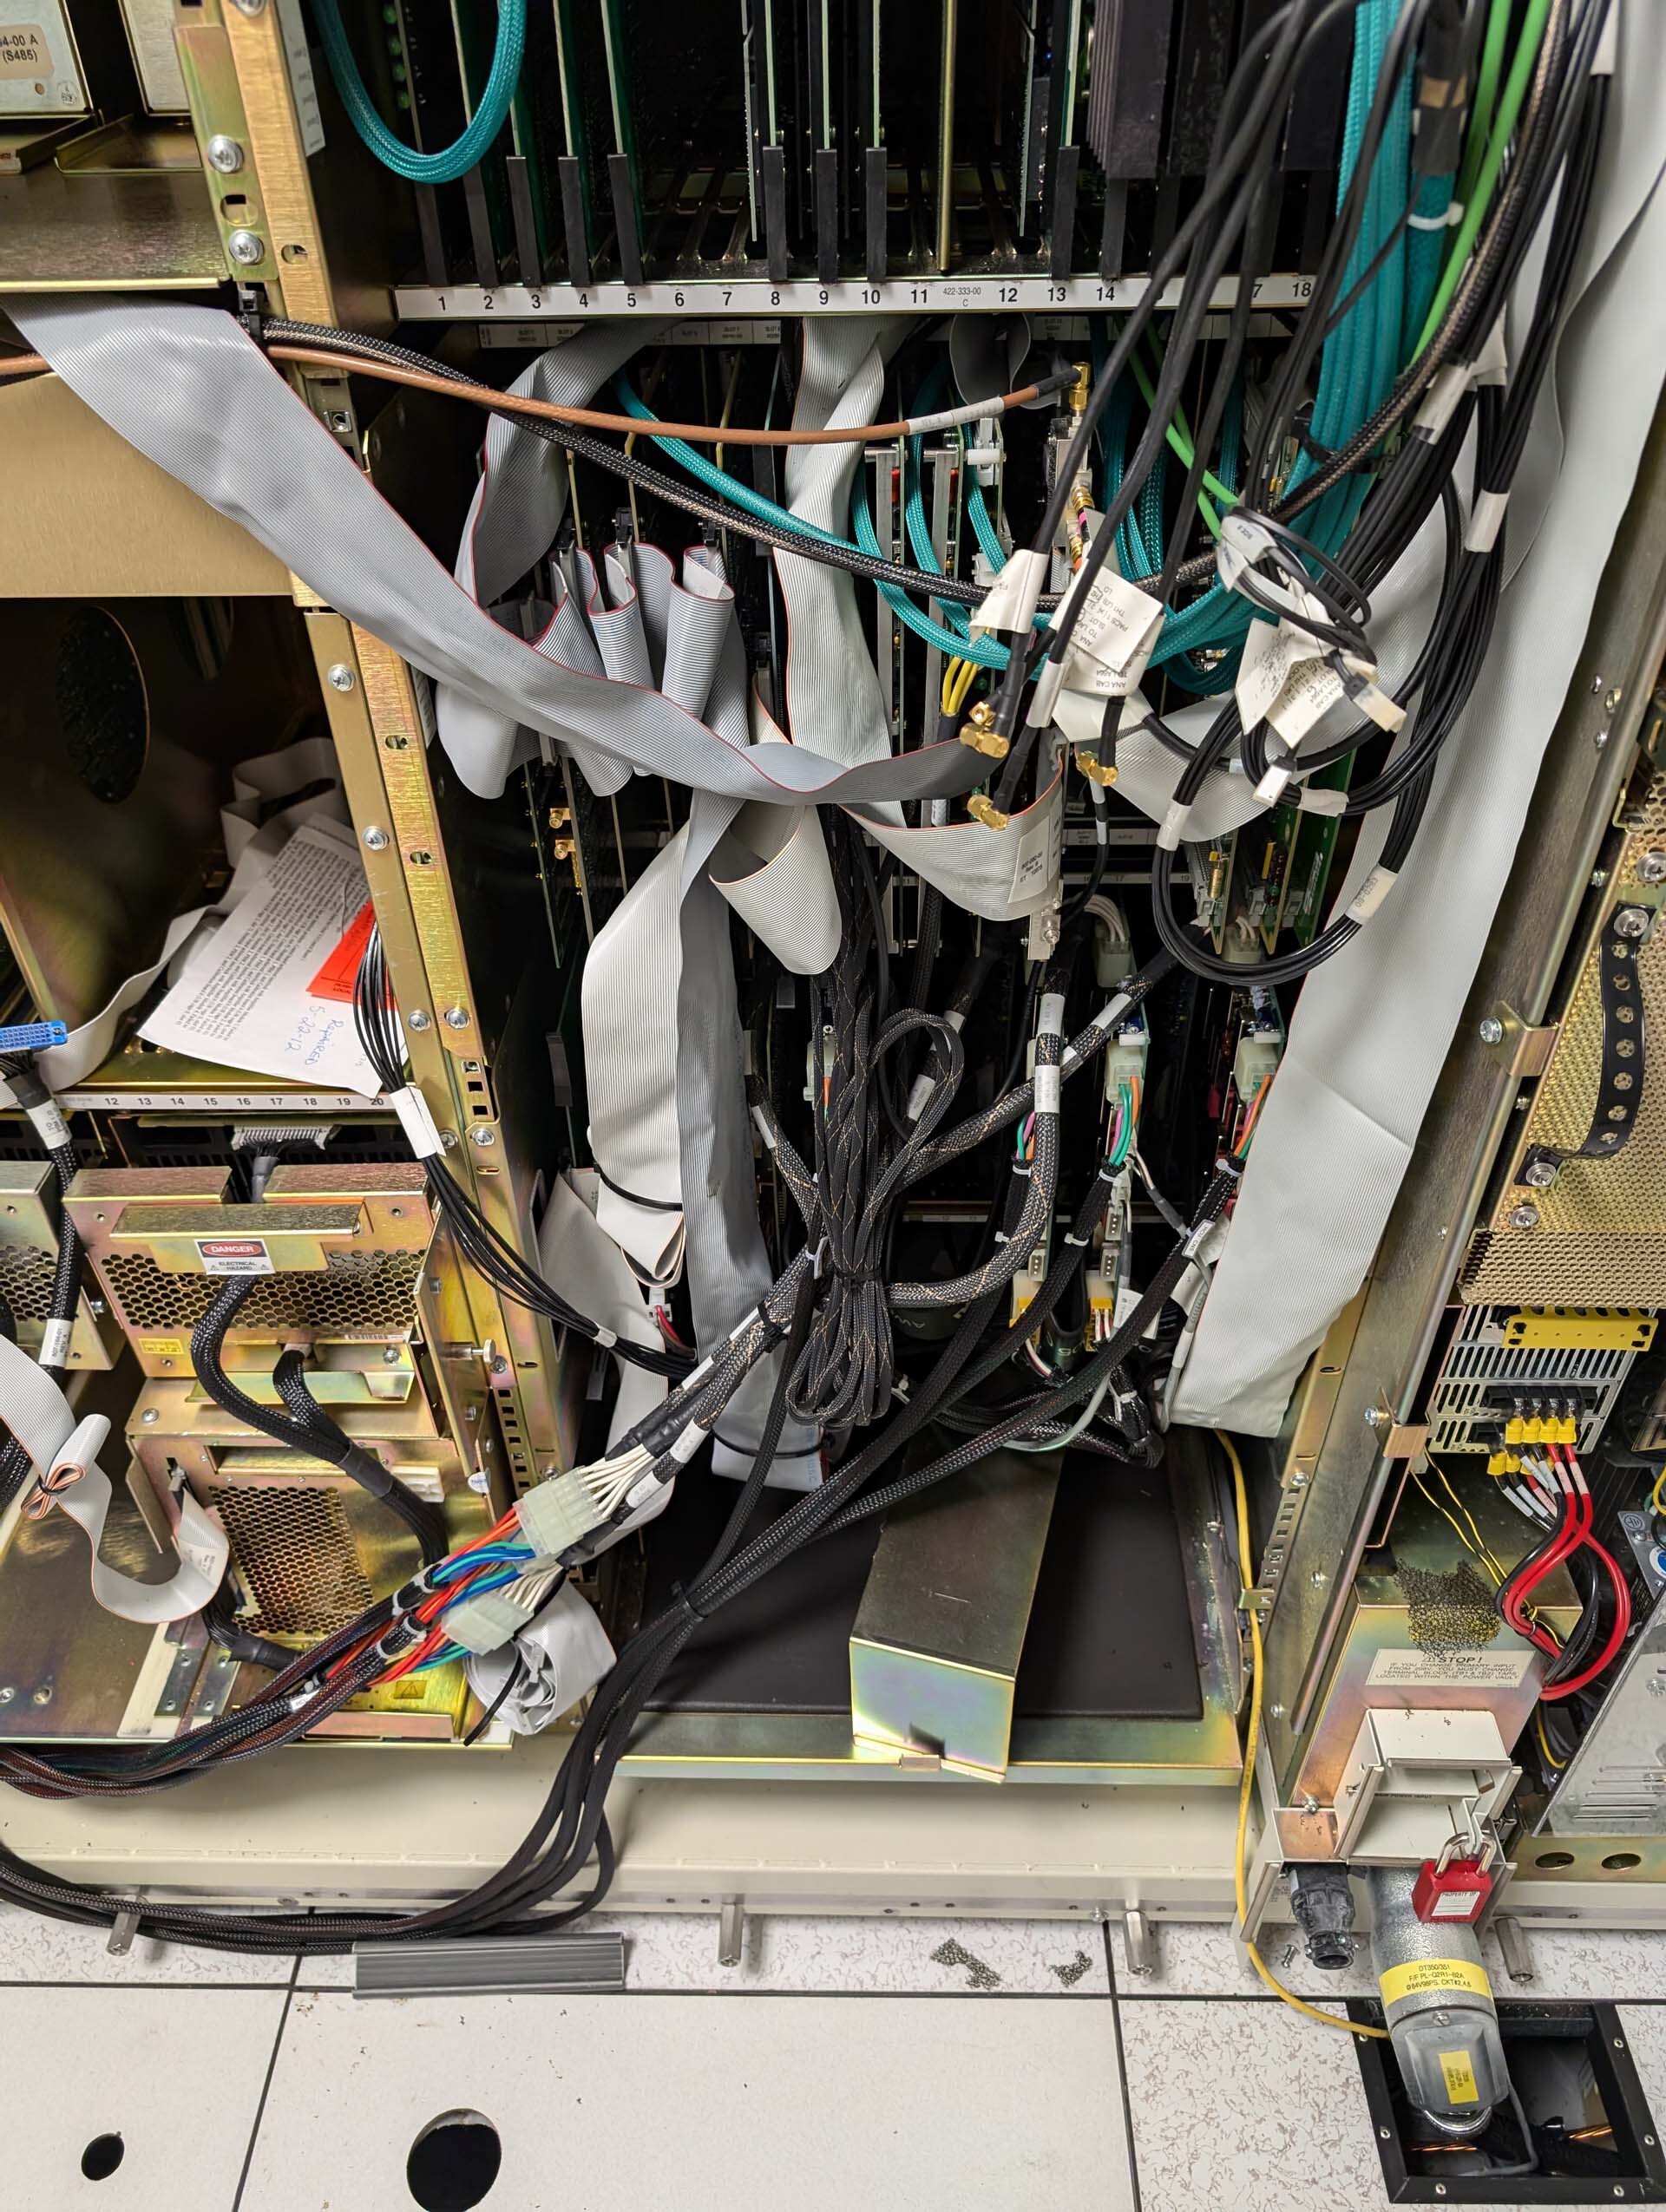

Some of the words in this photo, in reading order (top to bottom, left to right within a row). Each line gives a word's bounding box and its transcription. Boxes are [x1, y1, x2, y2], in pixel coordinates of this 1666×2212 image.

[30, 34, 38, 45] A
[3, 49, 38, 63] (S485)
[438, 296, 447, 311] 1
[483, 296, 494, 310] 2
[530, 294, 541, 309] 3
[579, 293, 589, 308] 4
[626, 293, 637, 307] 5
[674, 291, 685, 307] 6
[722, 291, 731, 306] 7
[771, 291, 781, 305] 8
[819, 291, 829, 305] 9
[862, 289, 881, 304] 10
[910, 289, 928, 304] 11
[999, 287, 1018, 303] 12
[1047, 286, 1066, 301] 13
[1096, 286, 1115, 301] 14
[1291, 282, 1311, 297] 18
[942, 287, 981, 296] 422-333-00
[104, 1097, 119, 1106] 12
[137, 1097, 152, 1106] 13
[170, 1097, 185, 1106] 14
[204, 1097, 218, 1106] 15
[237, 1097, 252, 1106] 16
[270, 1097, 283, 1106] 17
[303, 1097, 318, 1106] 18
[337, 1097, 351, 1106] 19
[370, 1097, 384, 1106] 20
